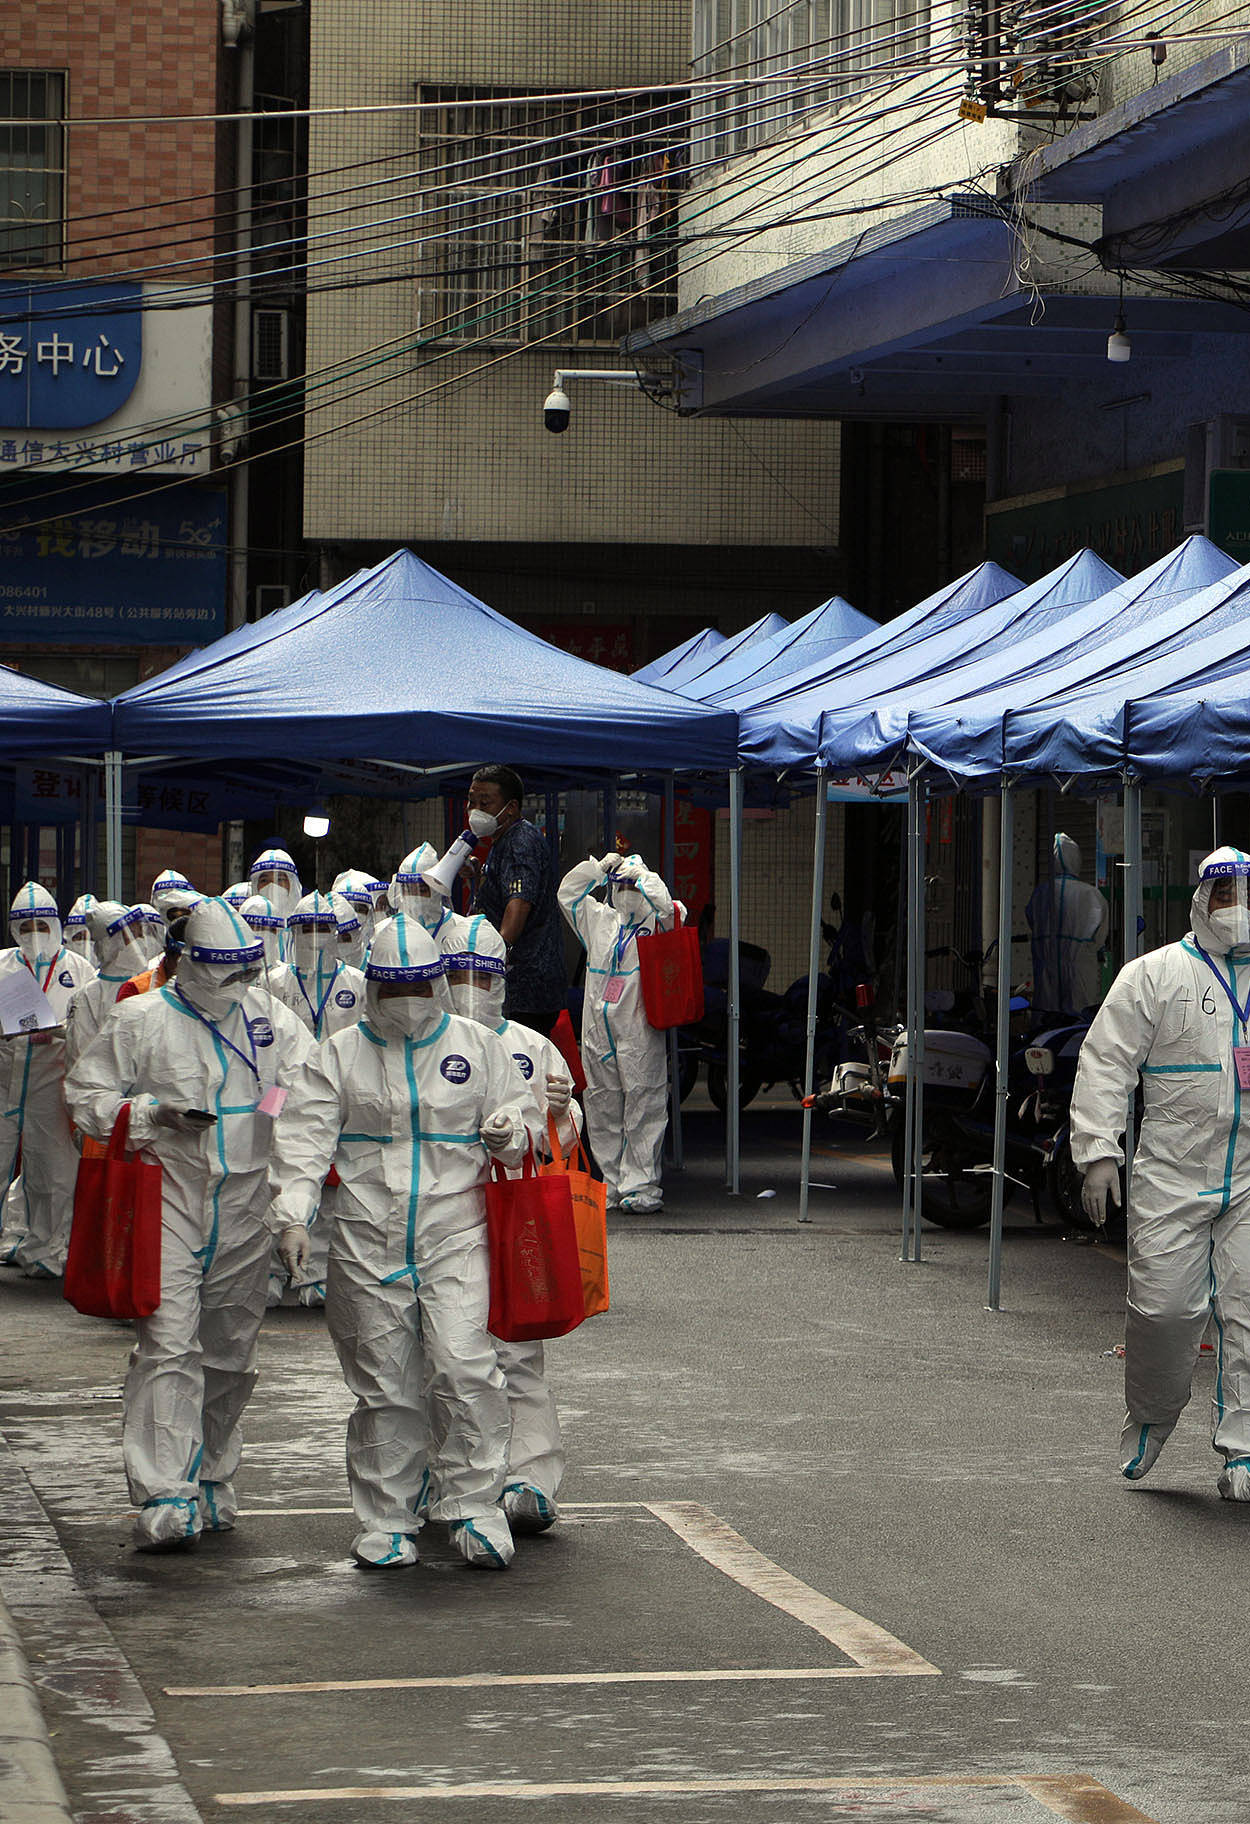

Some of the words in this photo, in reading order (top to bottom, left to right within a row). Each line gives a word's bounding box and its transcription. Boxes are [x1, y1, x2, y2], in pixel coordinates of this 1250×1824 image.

[0, 332, 125, 376] 务中心
[1209, 865, 1233, 875] FACE
[211, 952, 238, 961] FACE
[372, 969, 397, 980] FACE
[422, 964, 444, 977] SHIEL
